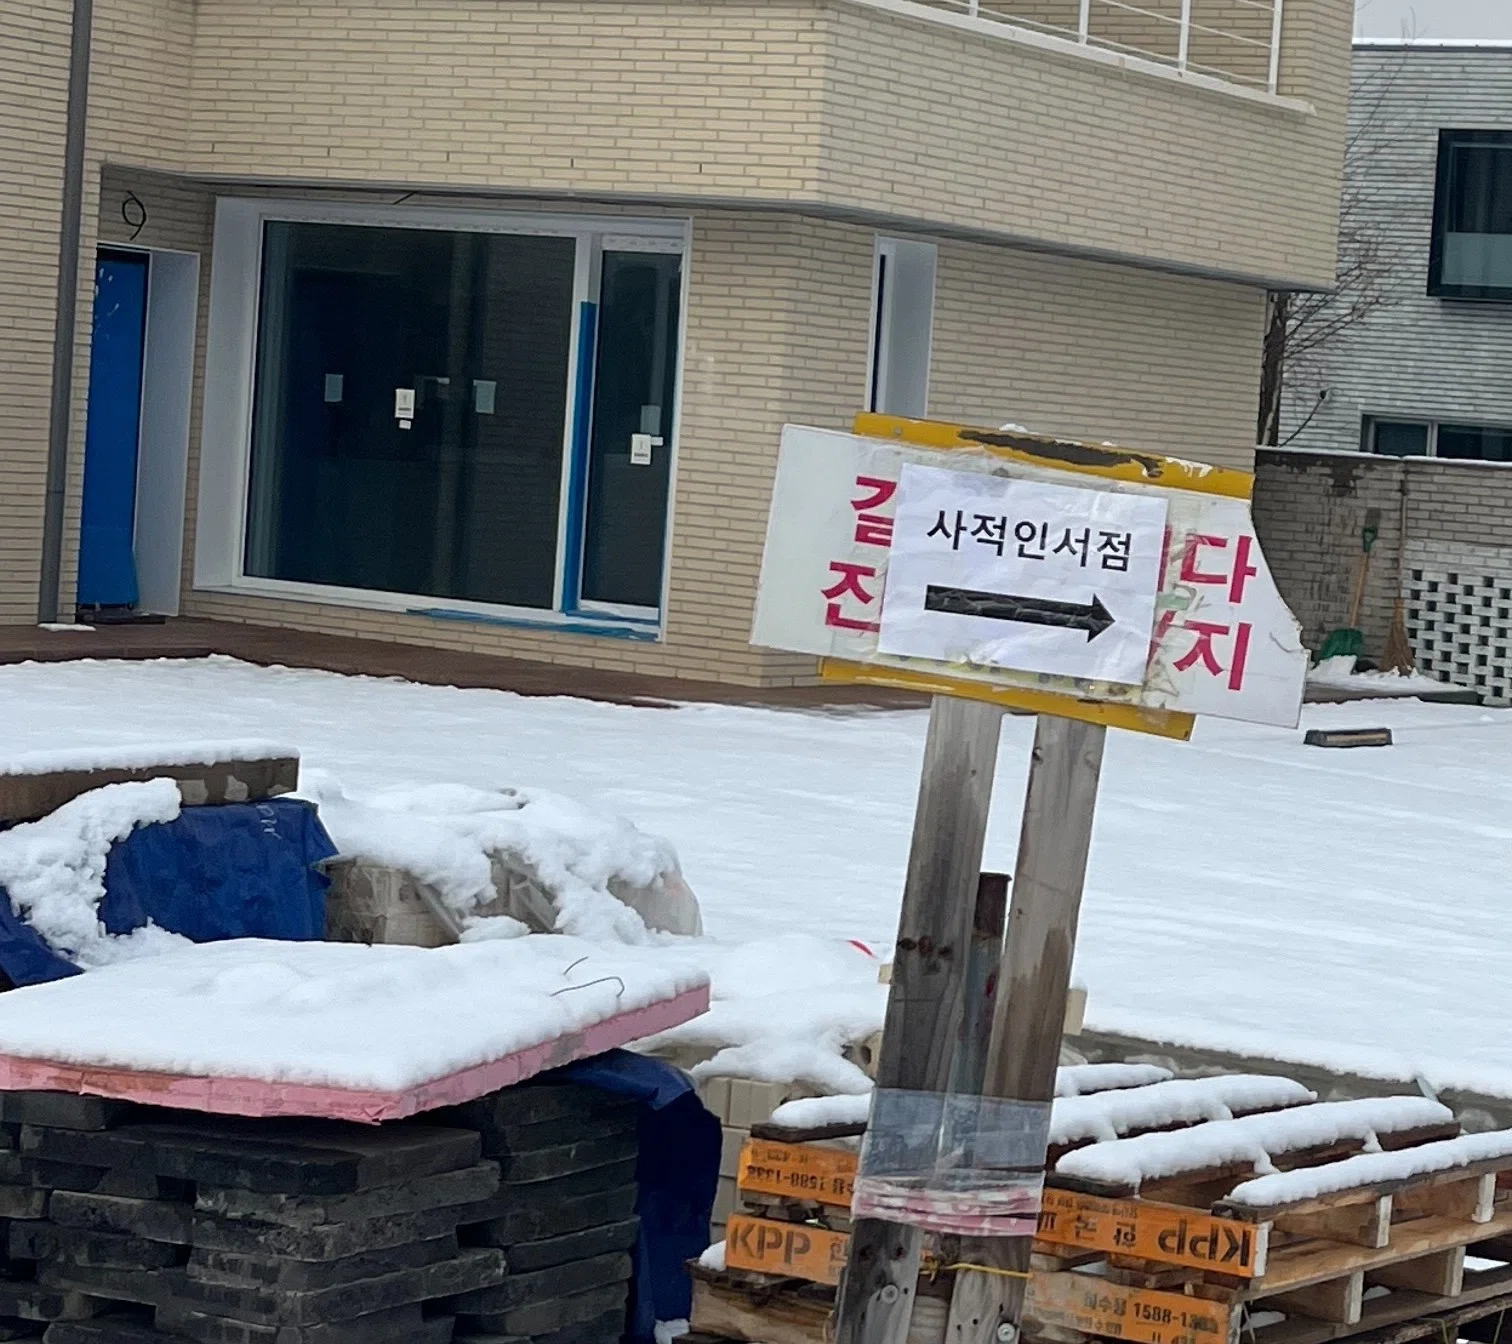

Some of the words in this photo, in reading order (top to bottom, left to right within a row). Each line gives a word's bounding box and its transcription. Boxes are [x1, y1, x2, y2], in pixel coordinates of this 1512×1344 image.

[926, 510, 1132, 573] 사적인서점
[731, 1223, 811, 1265] KPP
[1157, 1218, 1251, 1267] KPP
